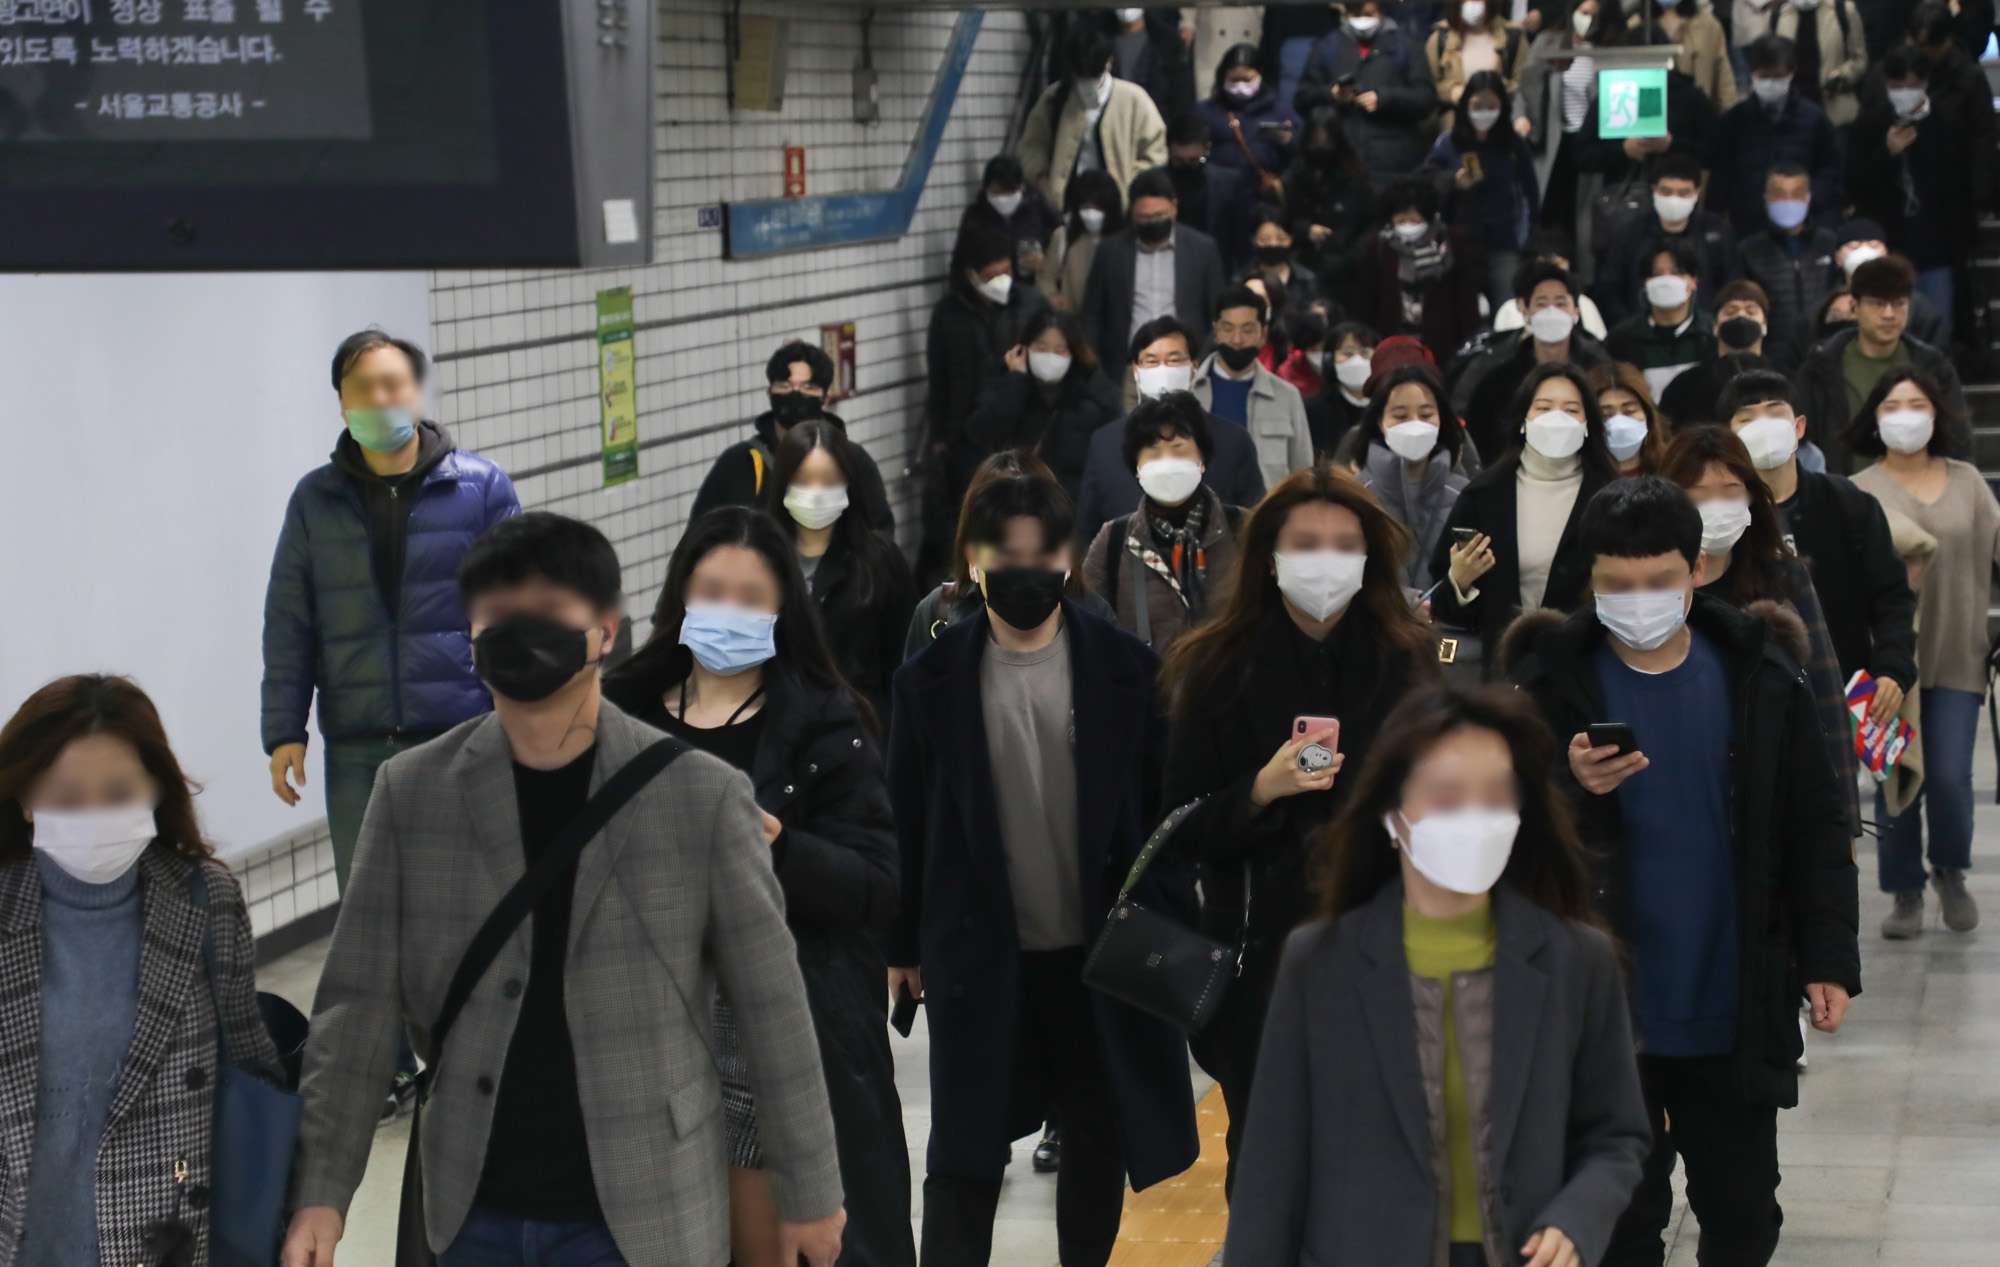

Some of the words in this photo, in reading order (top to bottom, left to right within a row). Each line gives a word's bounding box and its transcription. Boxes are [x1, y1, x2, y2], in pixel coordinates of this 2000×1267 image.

[111, 0, 163, 24] 정상
[304, 0, 332, 22] 수
[0, 37, 77, 65] 있도록
[91, 35, 282, 64] 노력하겠습니다.
[98, 92, 243, 119] 서울교통공사
